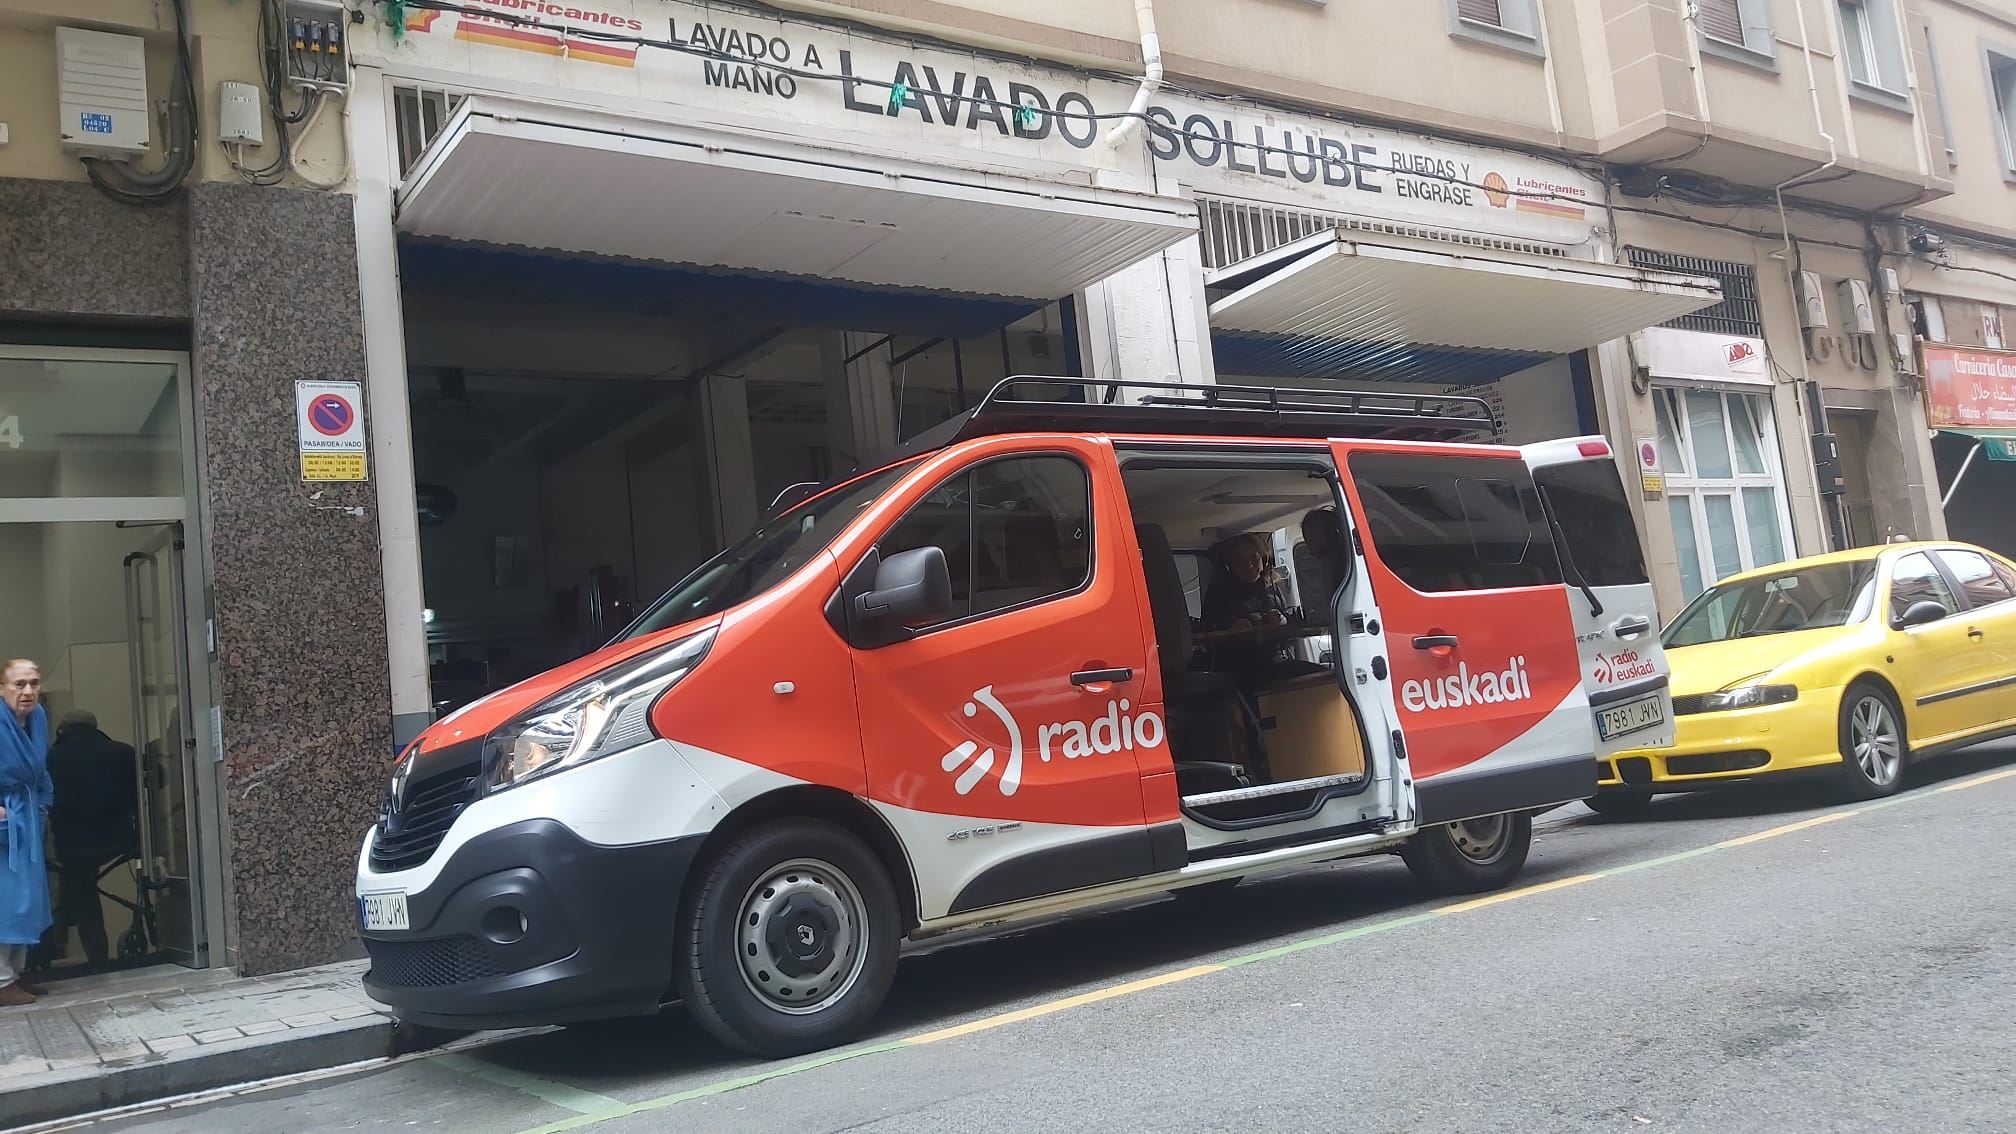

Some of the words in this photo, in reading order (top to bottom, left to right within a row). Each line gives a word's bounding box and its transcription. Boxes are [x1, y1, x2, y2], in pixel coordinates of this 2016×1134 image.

[482, 0, 643, 31] bricantes
[669, 18, 791, 63] LAVADO
[803, 44, 823, 70] A
[703, 60, 797, 100] MANO
[839, 50, 1097, 150] LAVADO
[1147, 106, 1382, 193] SOLLUBE
[1391, 151, 1457, 181] RUEDAS
[1460, 163, 1471, 181] Y
[1396, 178, 1474, 207] ENGRASE
[1516, 177, 1586, 197] Lubricantes
[1610, 647, 1639, 667] radio
[1616, 658, 1656, 682] euskadi
[1401, 655, 1531, 712] euskadi
[1038, 698, 1164, 762] radio
[1604, 707, 1635, 732] 7981
[1639, 701, 1659, 722] JVN
[387, 895, 406, 926] JVN
